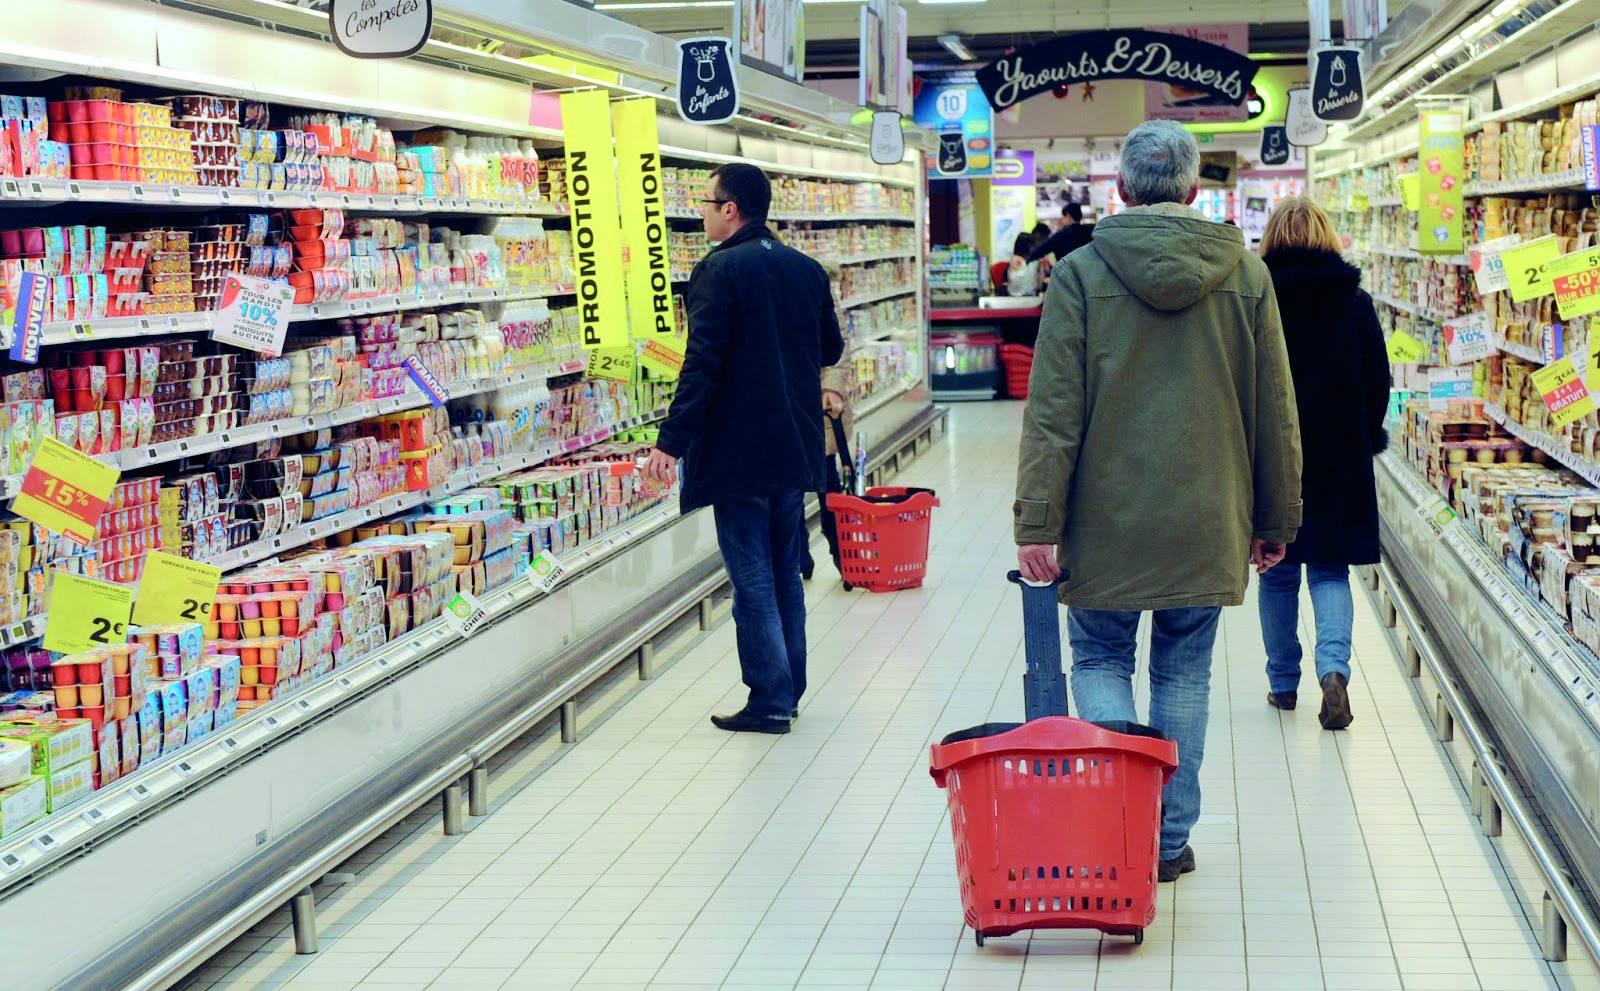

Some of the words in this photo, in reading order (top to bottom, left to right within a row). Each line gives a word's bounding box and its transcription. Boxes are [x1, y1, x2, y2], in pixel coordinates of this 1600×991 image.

[994, 51, 1100, 107] Yaourts
[1101, 36, 1143, 73] &
[1136, 43, 1242, 99] Desserts
[688, 86, 731, 114] Enfants
[943, 96, 960, 112] 10
[1318, 90, 1359, 114] Desserts
[570, 151, 601, 346] PROMOTION
[640, 152, 671, 333] PROMOTION
[241, 295, 281, 310] MARDIS
[243, 290, 265, 300] TOUS
[267, 296, 283, 305] LES
[24, 275, 48, 362] NOUVEAU
[239, 302, 278, 327] 10%
[232, 330, 273, 344] AUCHAN
[233, 324, 274, 339] PRODUITS
[1459, 330, 1485, 343] 10%
[1550, 388, 1585, 412] GRATUIT
[43, 479, 89, 507] 15%
[544, 568, 564, 588] CHER
[463, 610, 486, 632] CHER
